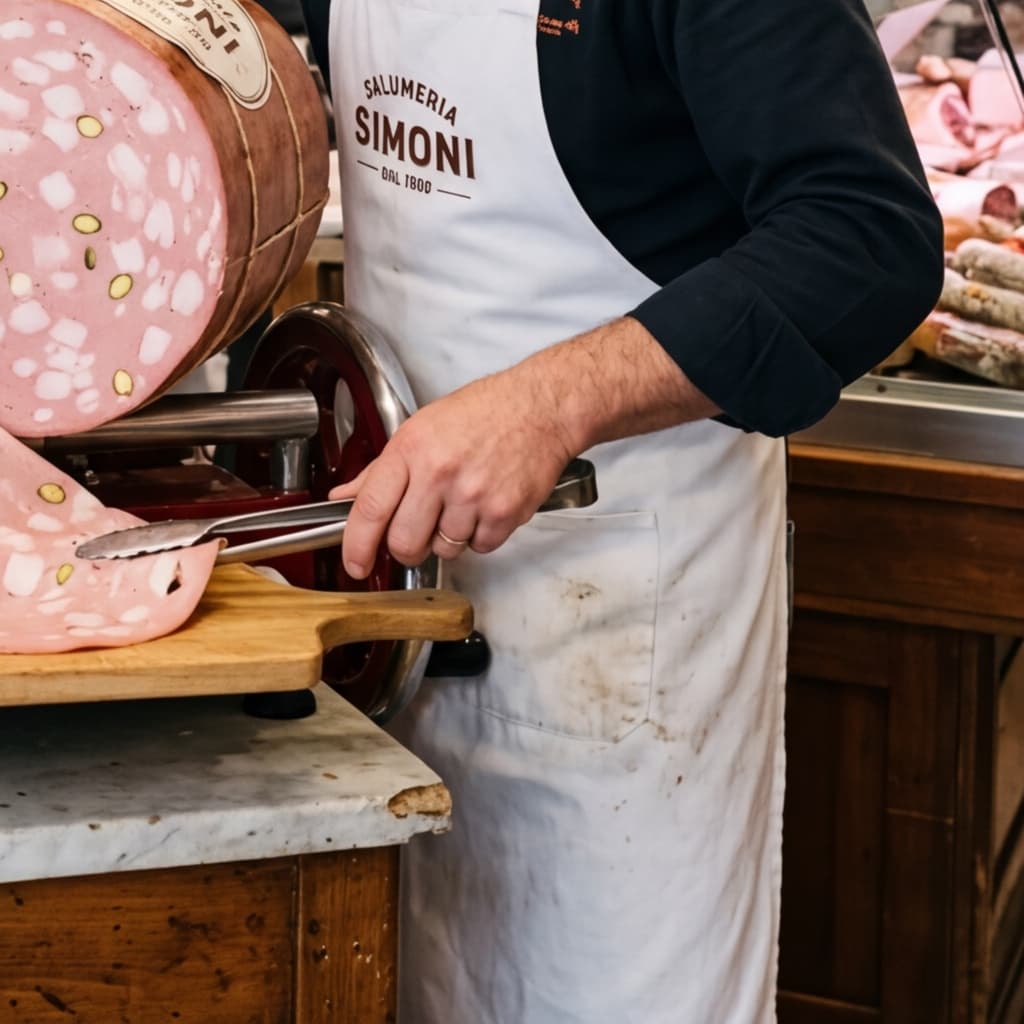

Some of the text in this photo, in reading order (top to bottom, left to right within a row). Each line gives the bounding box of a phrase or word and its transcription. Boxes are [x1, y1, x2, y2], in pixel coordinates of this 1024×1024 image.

[364, 74, 457, 126] SALUMERIA
[355, 105, 476, 180] SIMONI
[381, 166, 400, 186] DAL
